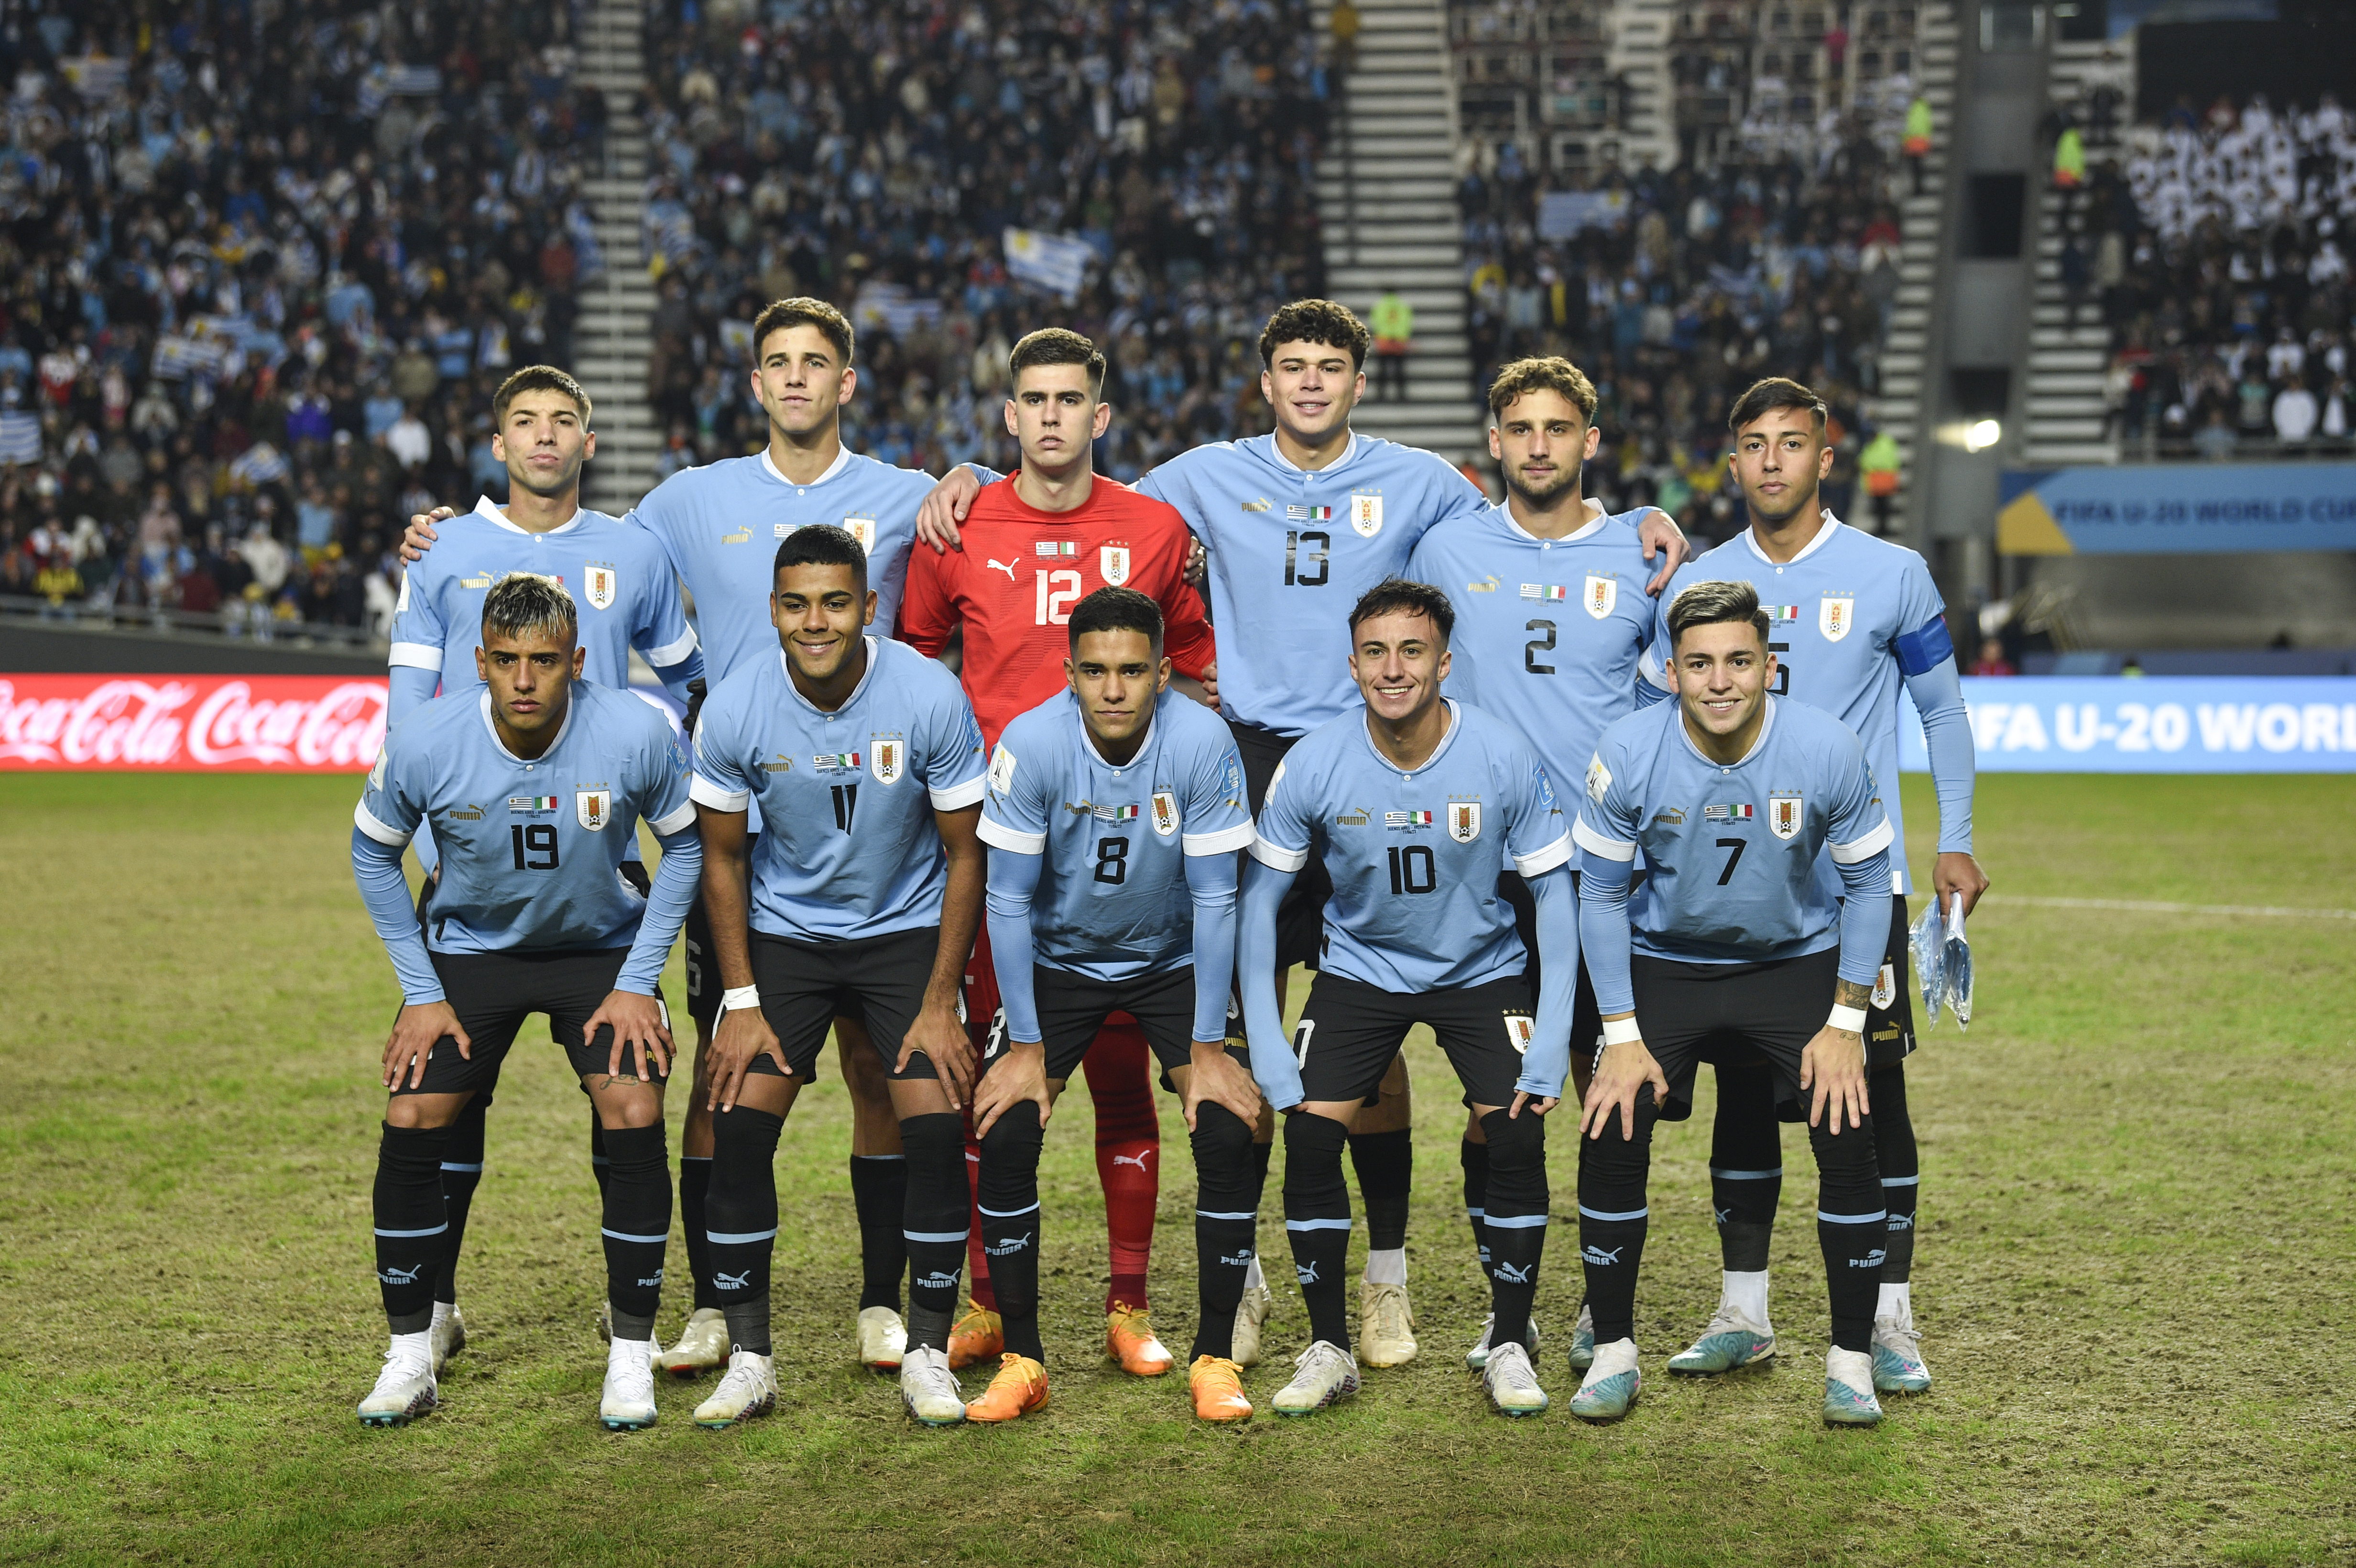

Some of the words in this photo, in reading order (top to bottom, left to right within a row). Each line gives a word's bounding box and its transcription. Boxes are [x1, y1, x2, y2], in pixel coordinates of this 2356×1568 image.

[1285, 531, 1330, 586] 13
[460, 578, 490, 589] PUMA
[1036, 570, 1081, 625] 12
[1526, 619, 1556, 675] 2
[2055, 703, 2191, 752] U-20
[449, 810, 480, 820] PUMA
[830, 784, 857, 837] 11
[1336, 817, 1366, 826] PUMA
[511, 824, 559, 870] 19
[1094, 837, 1129, 885] 8
[1387, 846, 1436, 895] 10
[1716, 838, 1747, 886] 7
[687, 938, 701, 997] 6
[984, 1007, 1006, 1059] 8
[1873, 1029, 1899, 1042] PUMA
[985, 1243, 1022, 1256] PUMA
[917, 1277, 952, 1288] PUMA
[1494, 1268, 1521, 1284] PUMA
